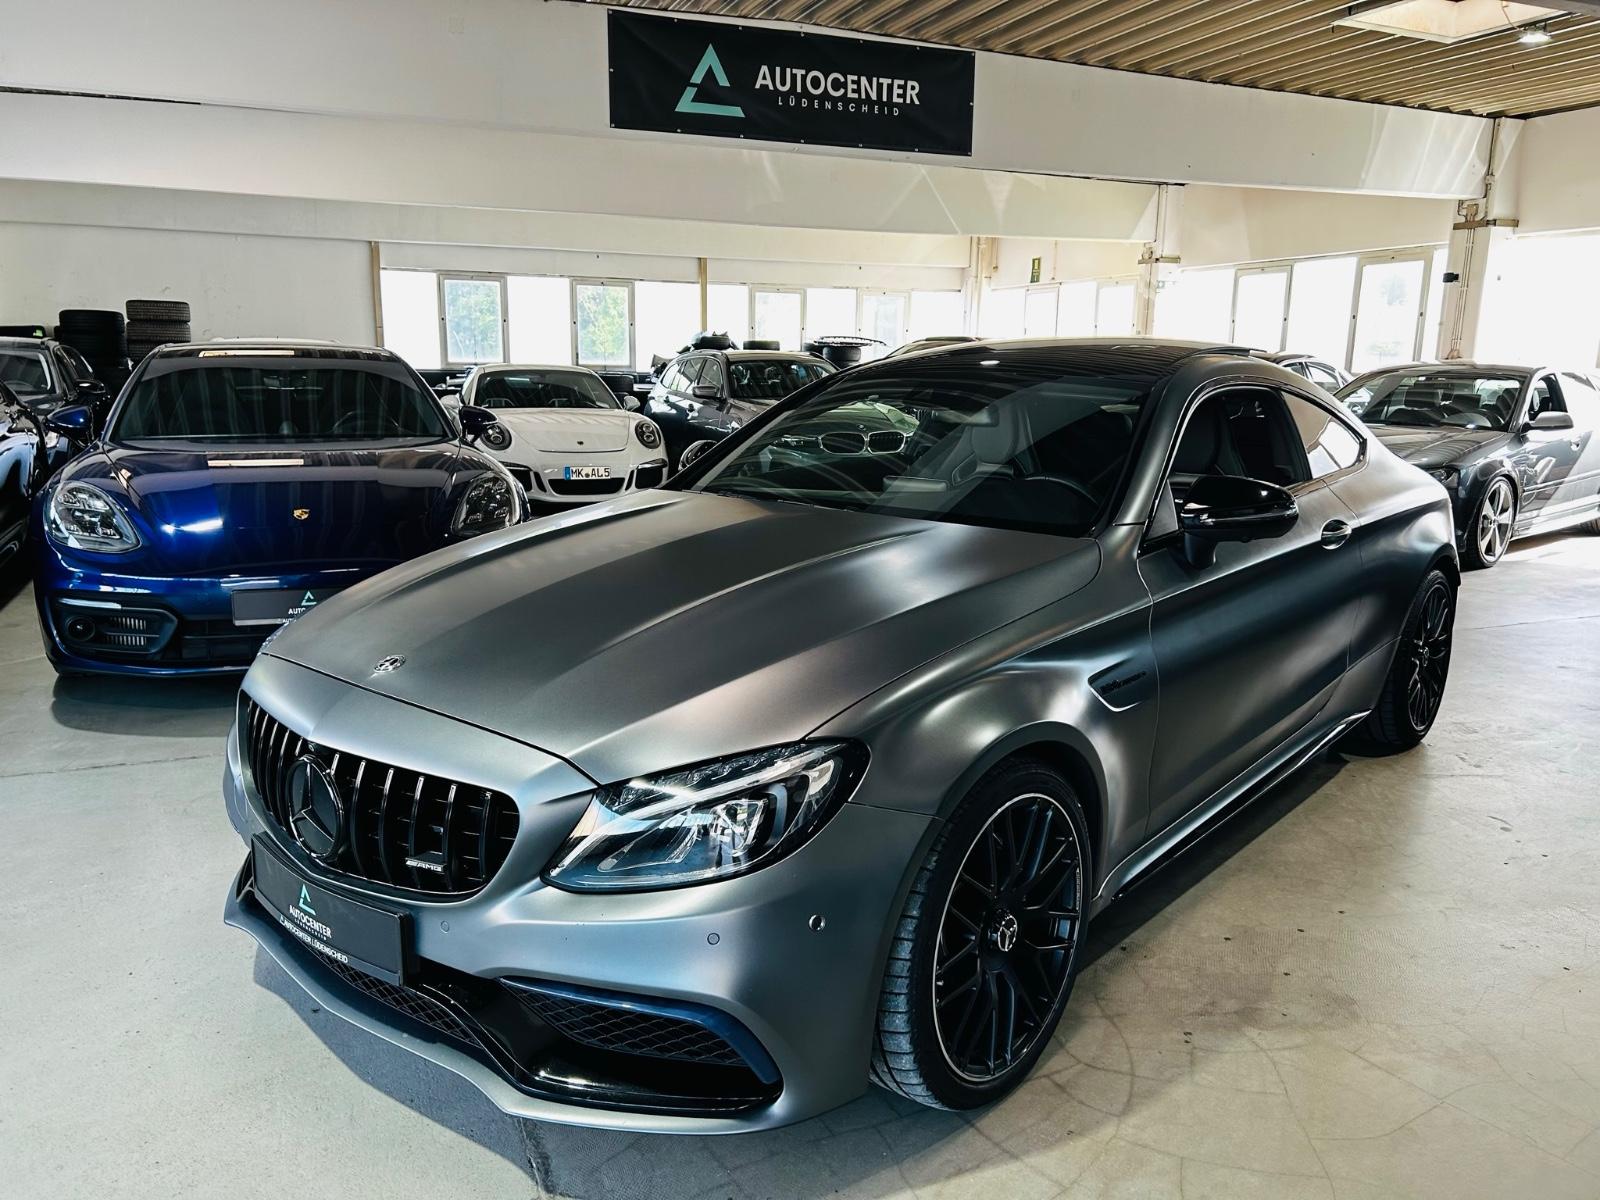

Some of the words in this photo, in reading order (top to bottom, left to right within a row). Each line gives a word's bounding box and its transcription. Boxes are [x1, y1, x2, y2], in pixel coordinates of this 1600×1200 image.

[755, 65, 920, 104] AUTOCENTER
[778, 95, 899, 116] LÜDENSCHEID
[571, 468, 583, 478] MK
[591, 467, 610, 478] AL5
[289, 905, 332, 938] AUTOCENTER
